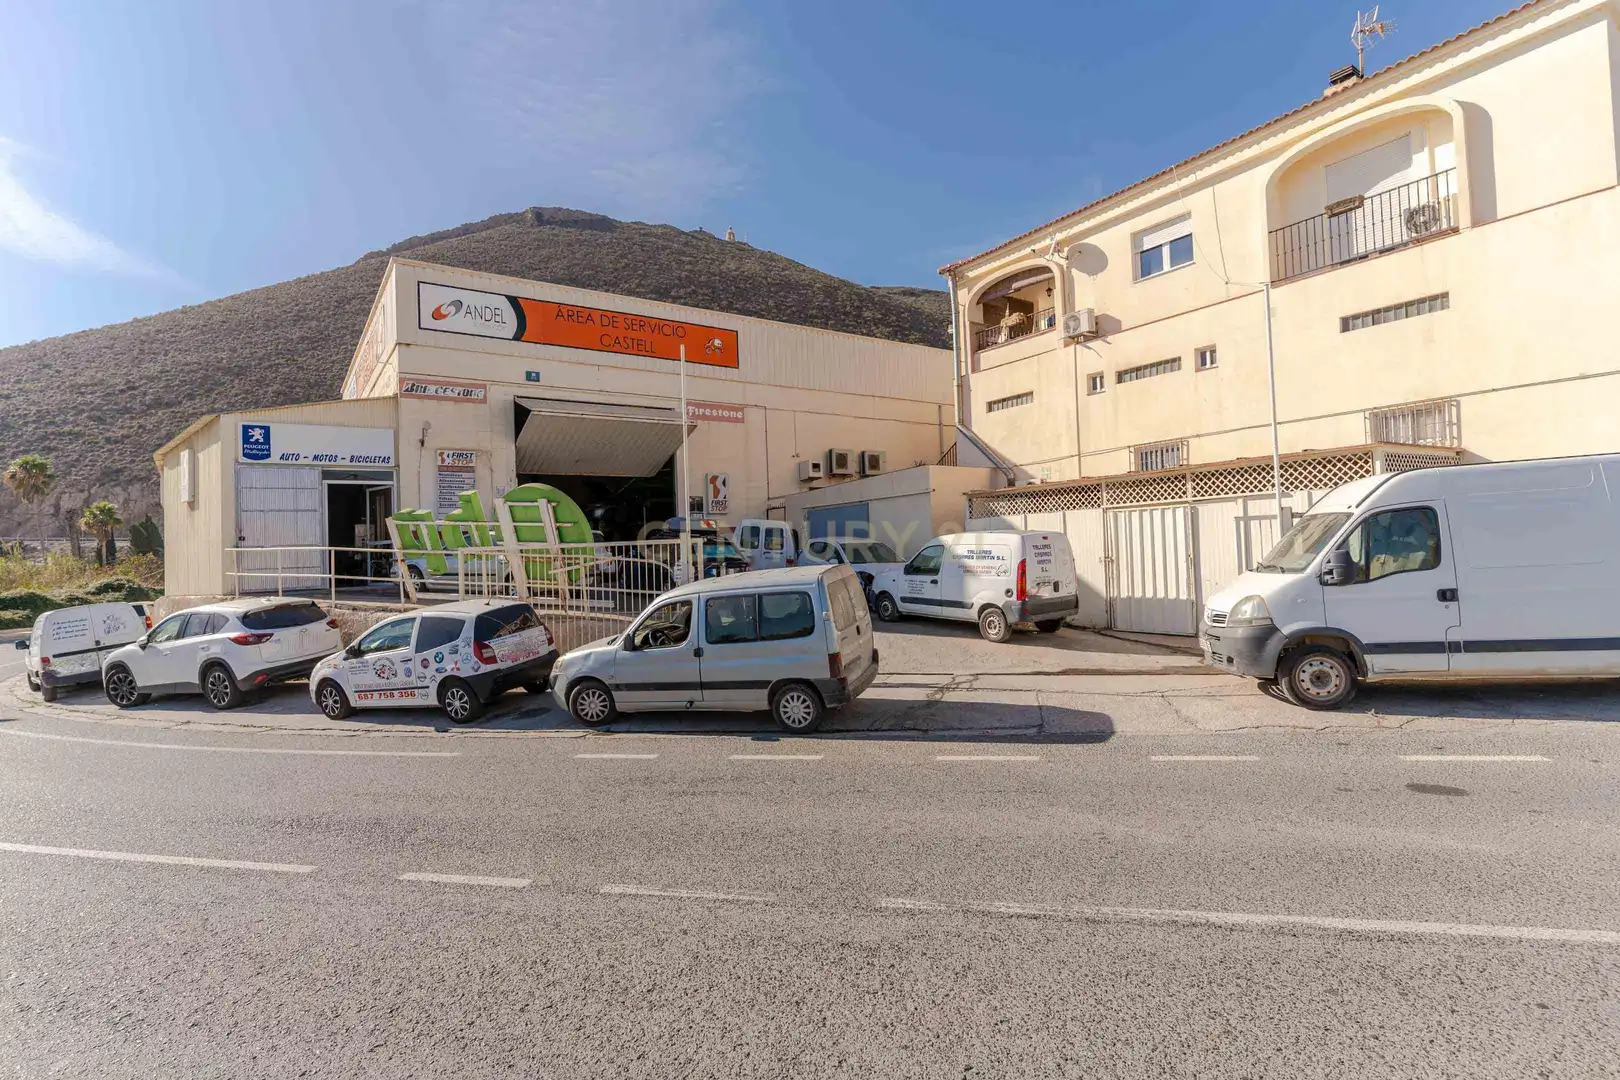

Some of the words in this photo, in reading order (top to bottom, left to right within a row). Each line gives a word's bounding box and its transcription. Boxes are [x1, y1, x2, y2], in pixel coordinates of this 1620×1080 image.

[463, 304, 507, 324] ANDEL
[554, 305, 596, 325] ÁREA
[600, 313, 619, 329] DE
[623, 317, 687, 339] SERVICIO
[599, 333, 657, 354] CASTELL
[403, 381, 485, 399] BRIGESTONE
[687, 405, 744, 418] Firestone
[279, 452, 300, 461] AUTO
[312, 453, 338, 463] MOTOS
[349, 454, 391, 464] BICICLETAS
[398, 690, 416, 698] 356
